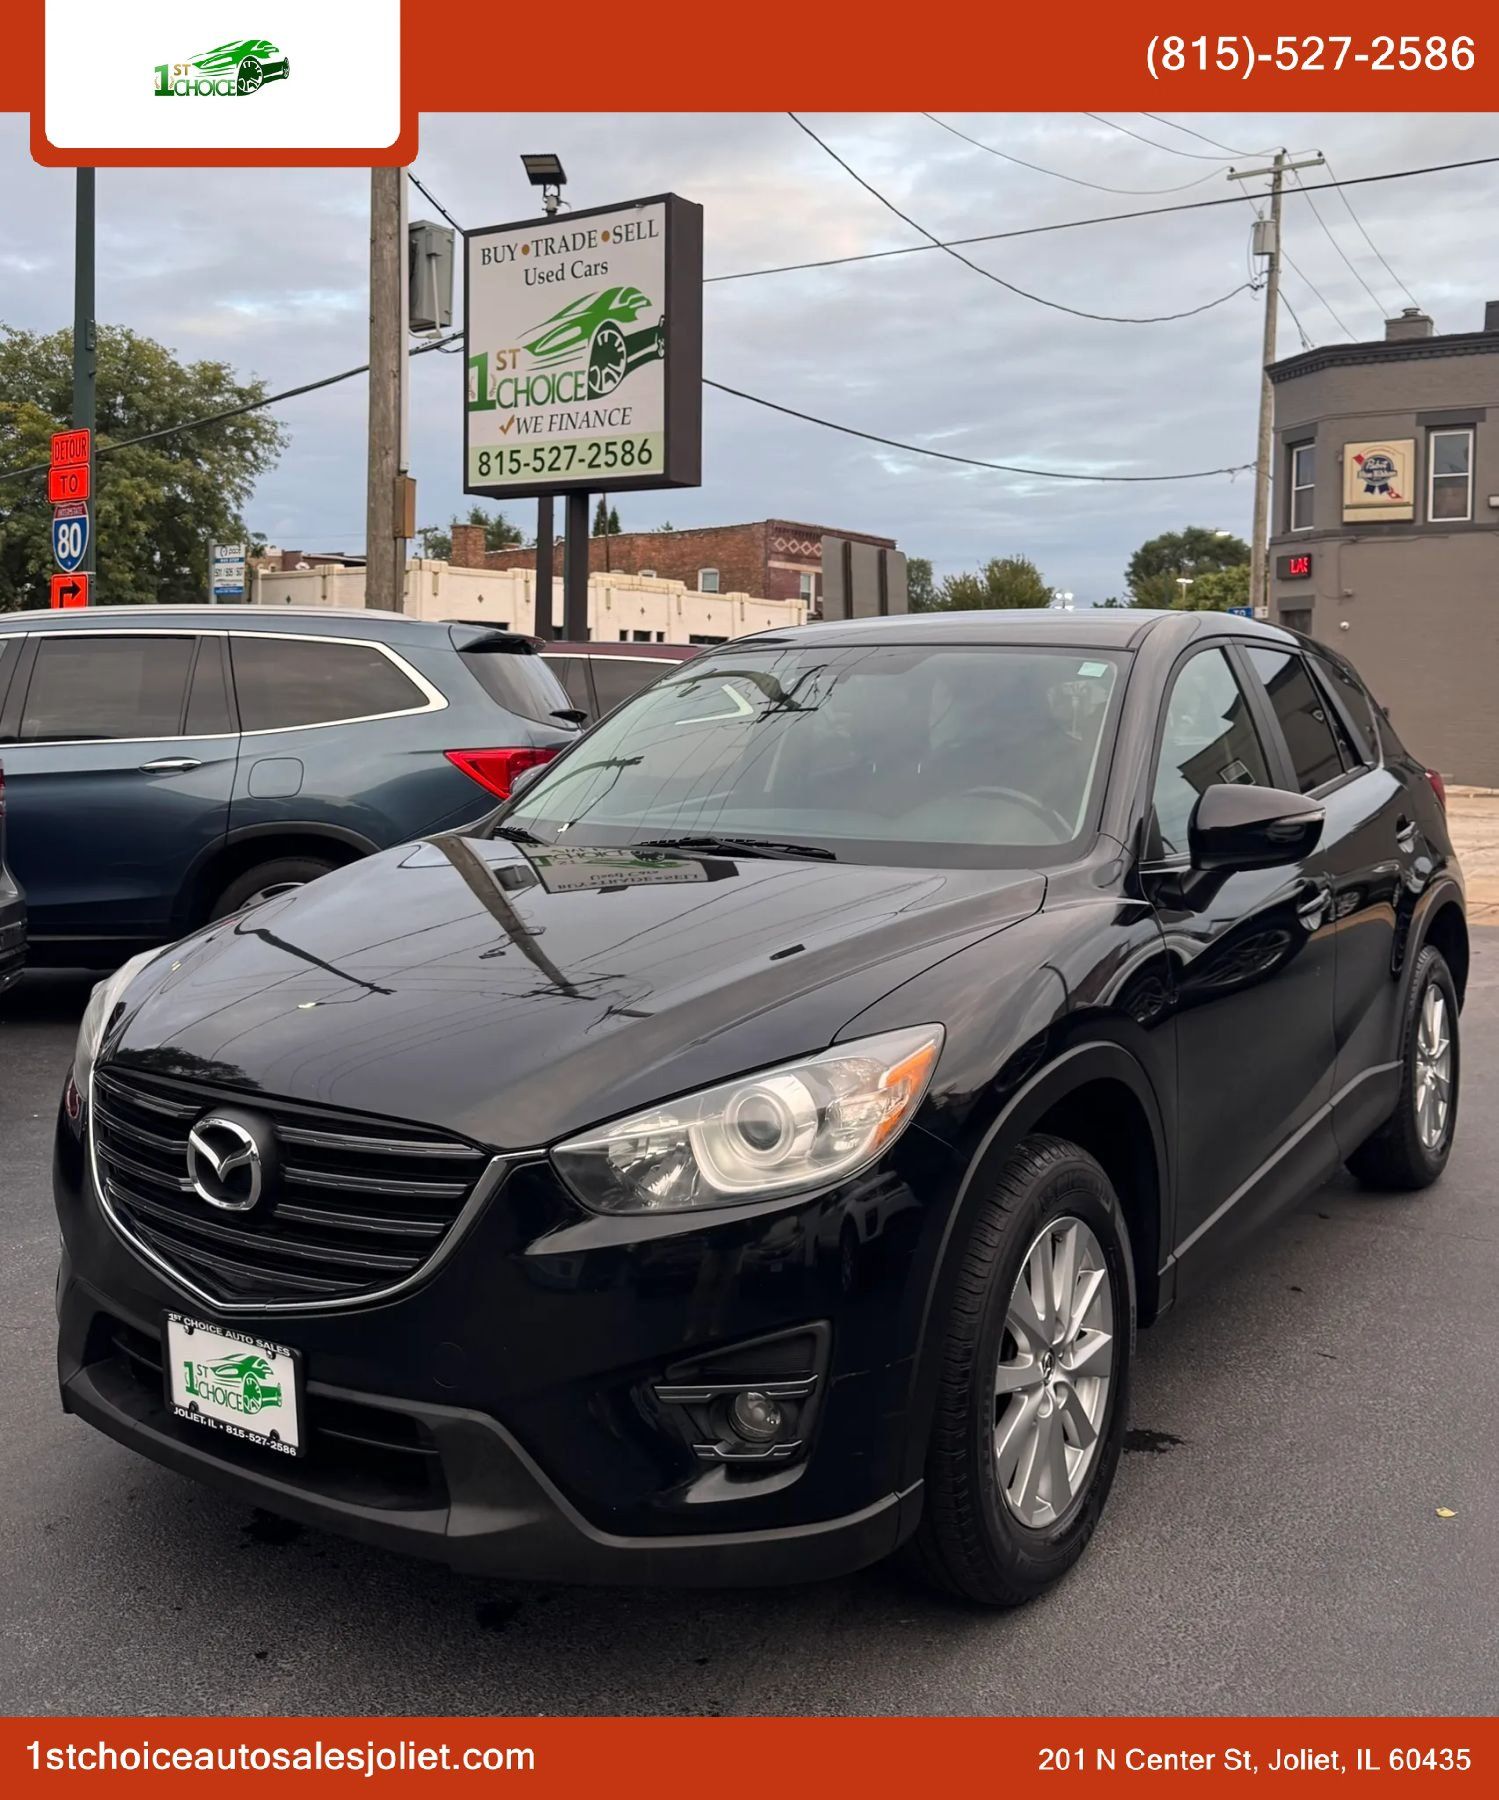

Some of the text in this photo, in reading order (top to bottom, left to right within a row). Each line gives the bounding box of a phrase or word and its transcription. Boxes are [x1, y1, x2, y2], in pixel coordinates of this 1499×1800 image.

[481, 219, 659, 266] BUY TRADE SELL
[524, 260, 608, 286] Used Cars
[496, 370, 587, 409] CHOICE
[516, 407, 633, 435] WE FINANCE
[55, 436, 87, 461] DETOUR
[478, 438, 652, 477] 815-527-2586
[60, 473, 78, 494] TO
[58, 522, 82, 559] 80
[168, 1313, 291, 1357] 1ST CHOICE AUTO SALES
[199, 1381, 243, 1412] CHOICE
[208, 1418, 218, 1429] IL
[225, 1425, 297, 1456] 815-527-2586
